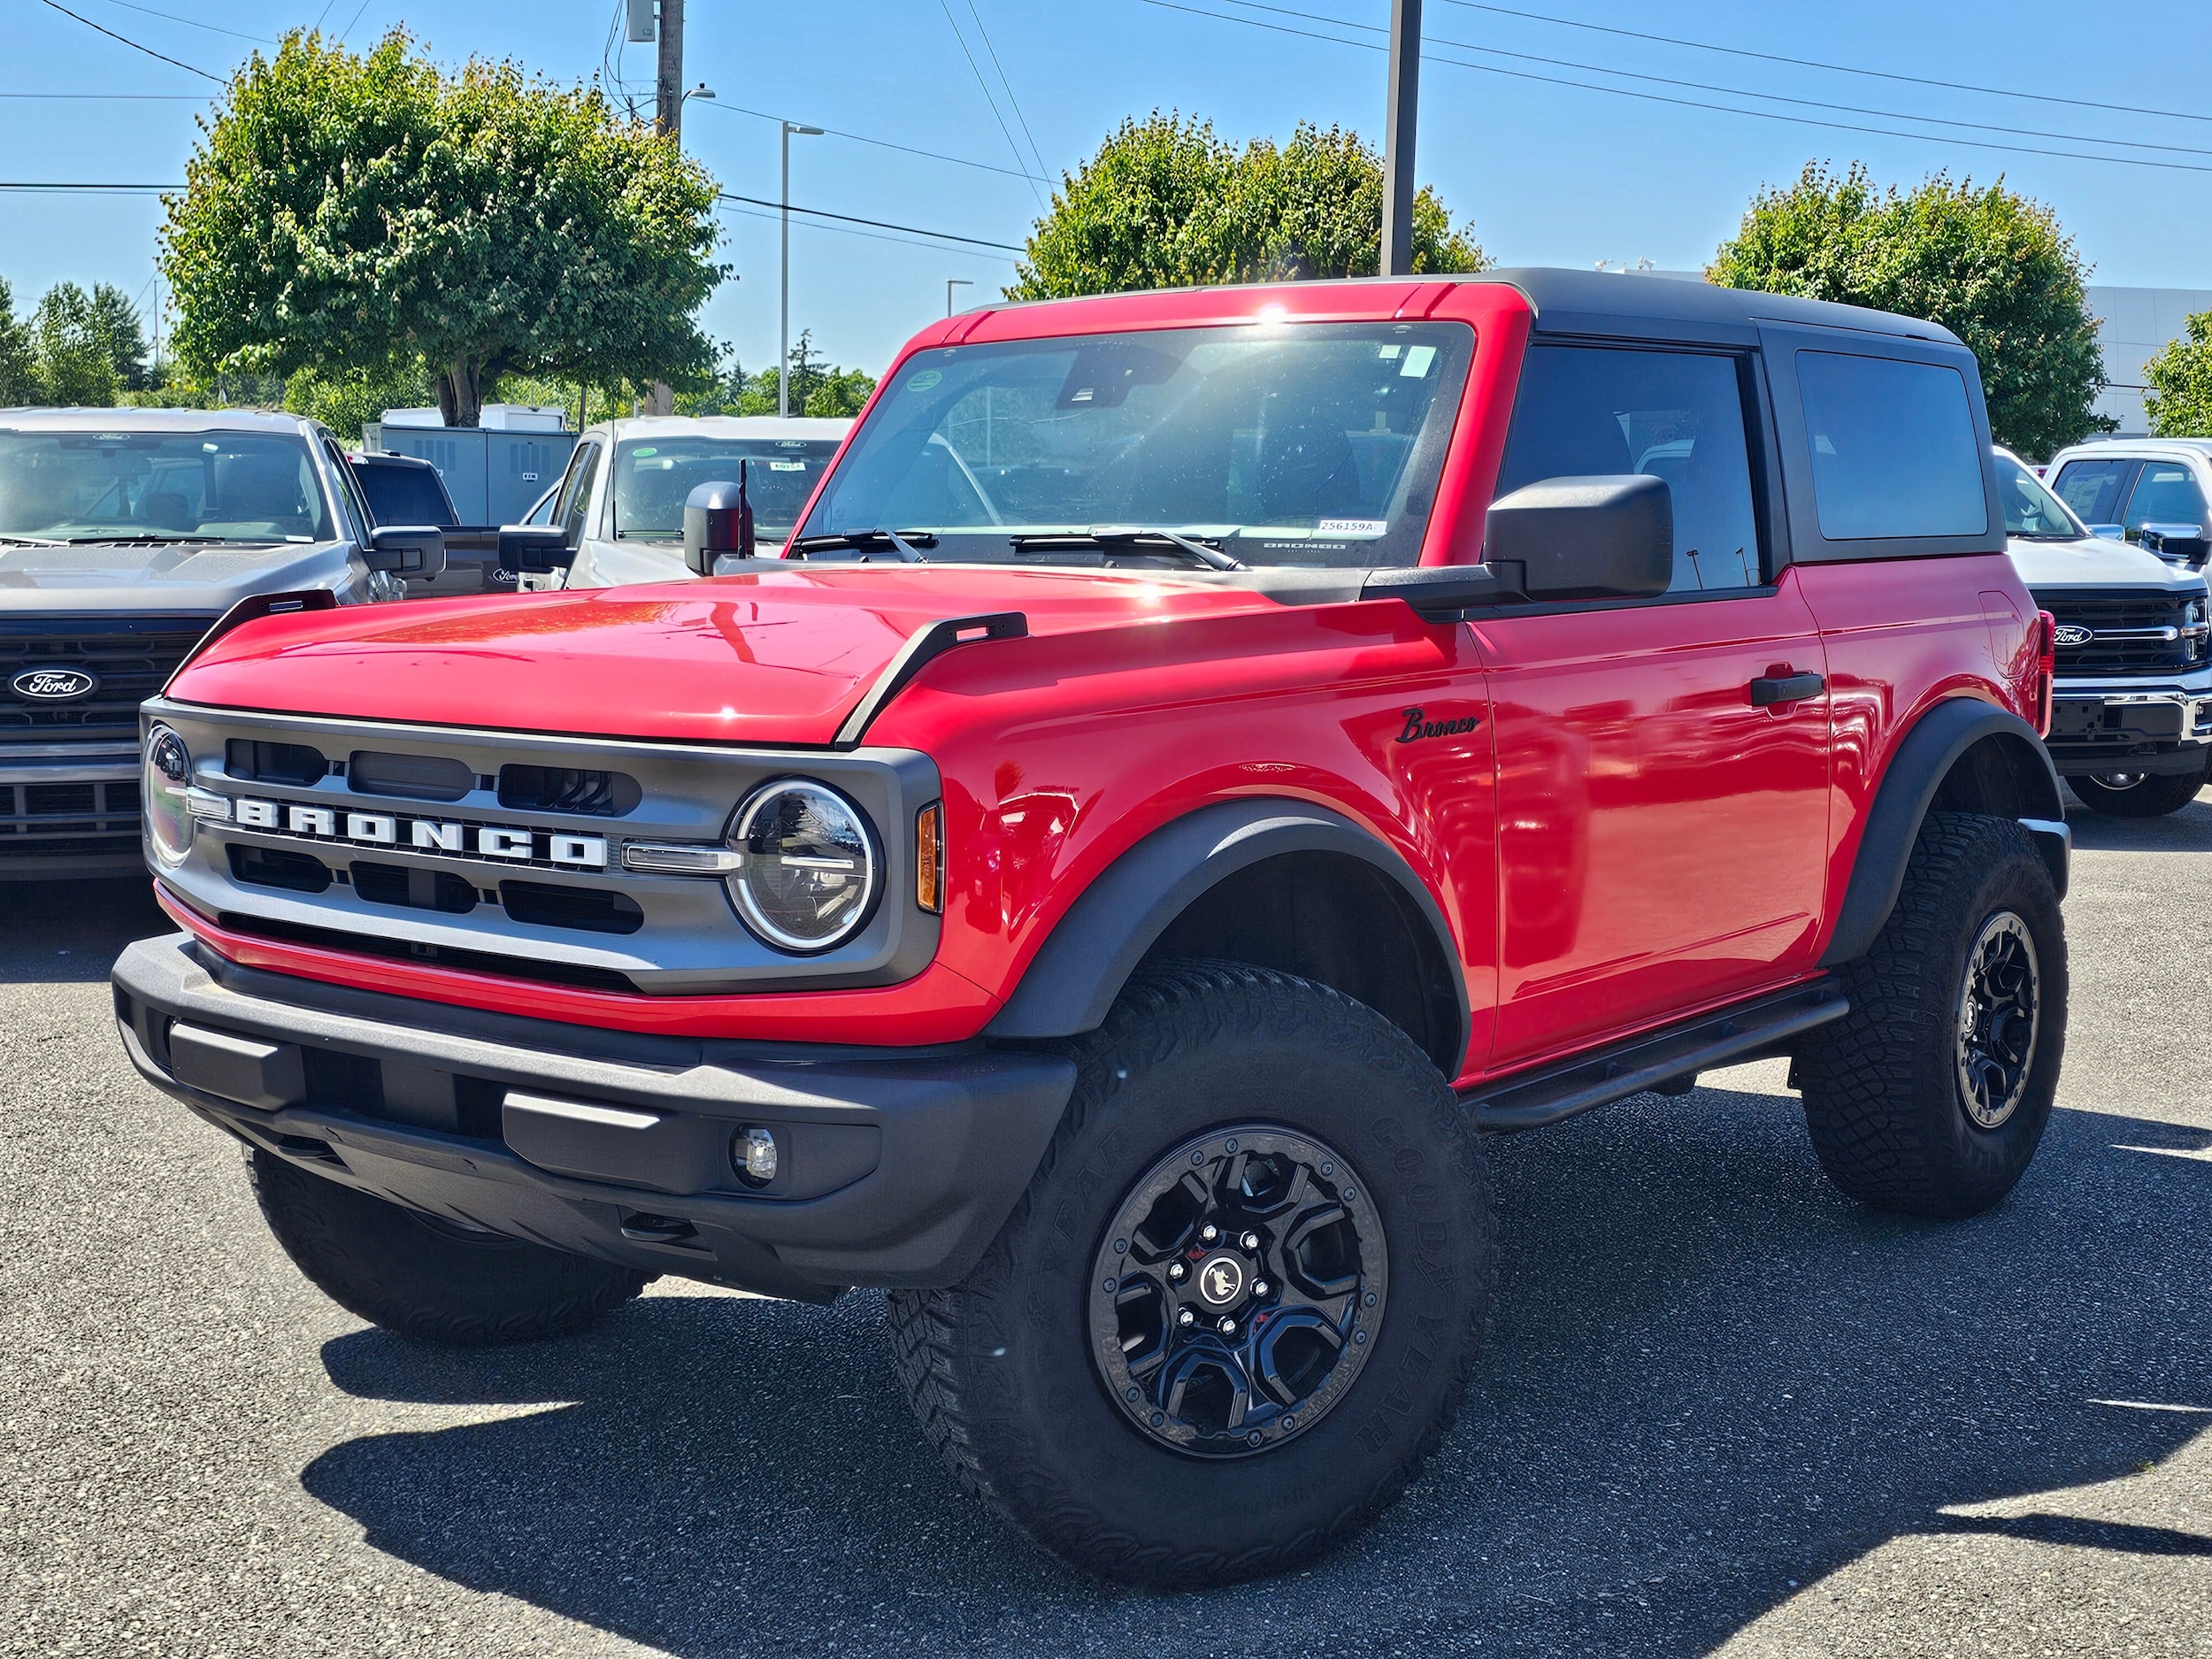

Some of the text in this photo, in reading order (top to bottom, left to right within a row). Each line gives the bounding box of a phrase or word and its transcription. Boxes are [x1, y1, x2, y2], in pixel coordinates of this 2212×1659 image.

[1321, 522, 1373, 531] 256159A
[2054, 628, 2084, 642] Ford
[29, 673, 77, 693] Ford
[1395, 708, 1481, 743] Bronco
[236, 798, 608, 867] BRONCO
